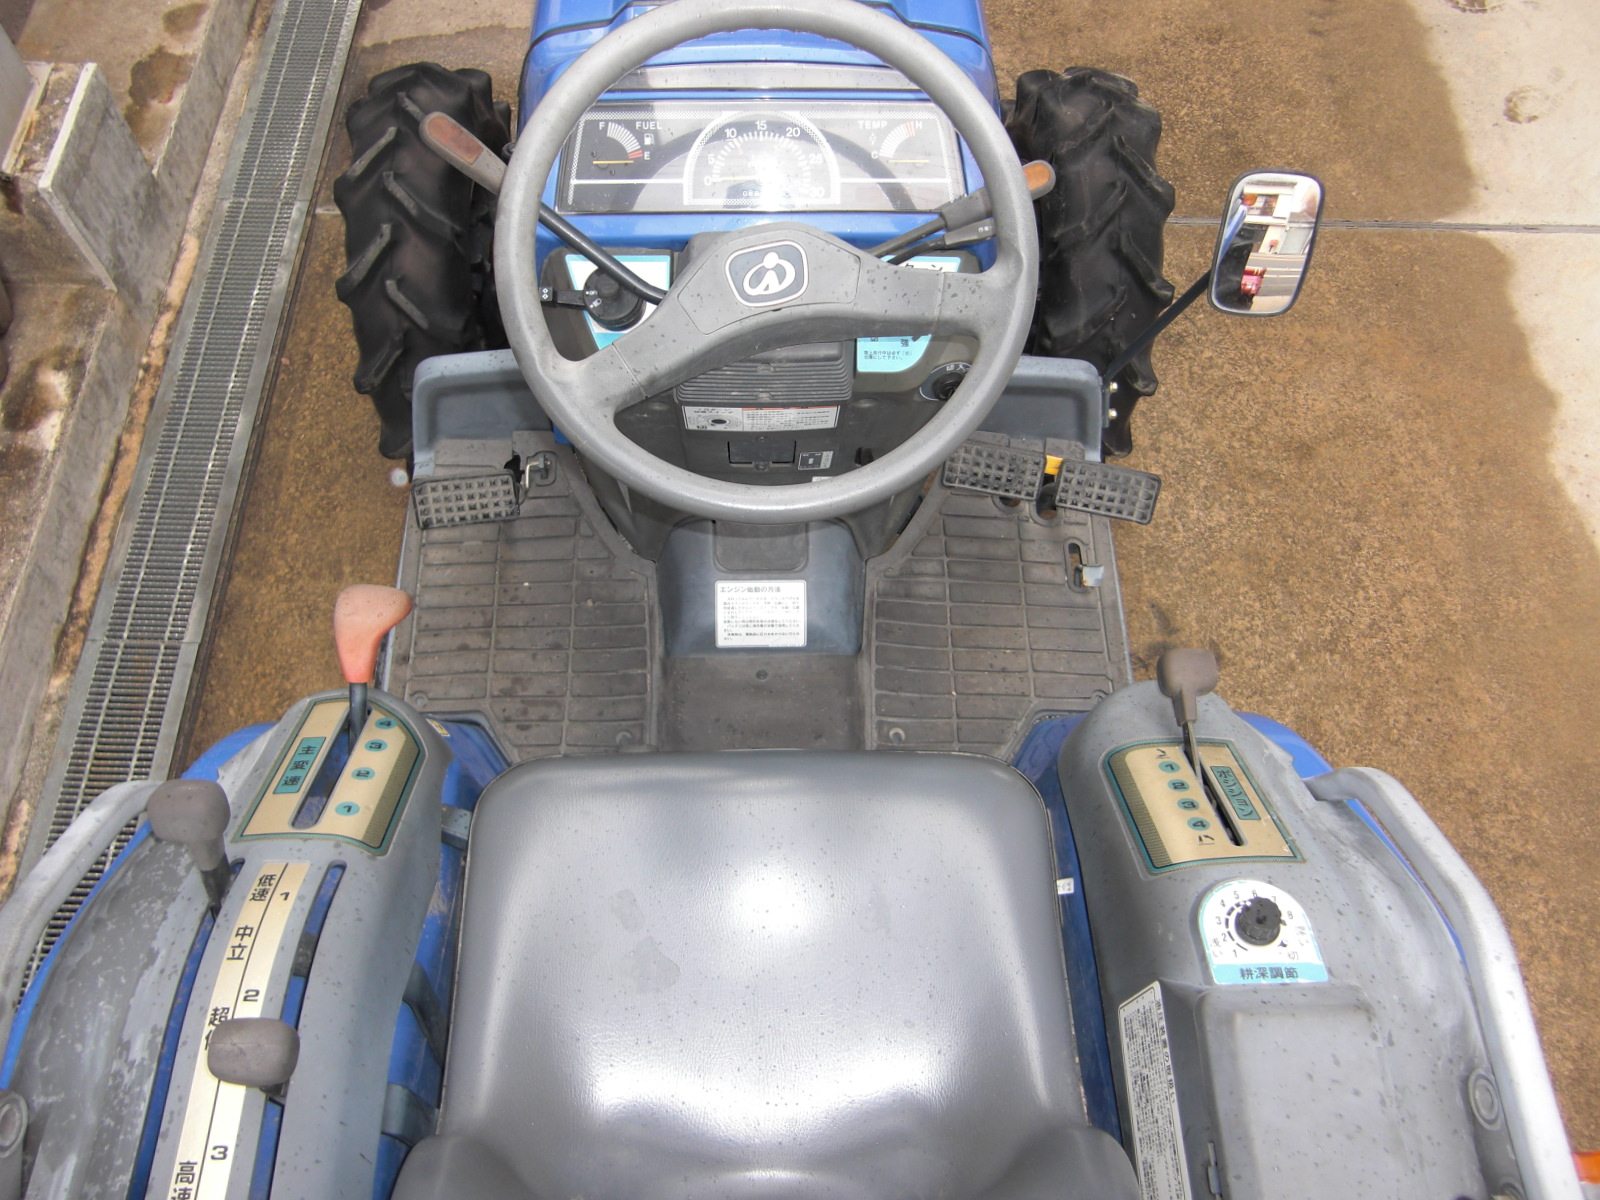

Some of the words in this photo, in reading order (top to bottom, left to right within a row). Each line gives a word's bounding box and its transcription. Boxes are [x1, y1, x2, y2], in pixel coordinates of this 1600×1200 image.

[599, 121, 606, 131] F
[635, 120, 663, 130] FUEL
[754, 120, 768, 131] 15
[857, 120, 888, 130] TEMP
[915, 120, 923, 129] H
[724, 128, 738, 139] 10
[785, 127, 801, 138] 20
[643, 150, 651, 161] E
[707, 154, 717, 165] 5
[808, 153, 823, 165] 25
[870, 151, 880, 160] C
[703, 176, 712, 186] 0
[808, 186, 825, 198] 30
[378, 719, 393, 728] 4
[368, 741, 383, 750] 3
[282, 746, 317, 787] 主変速
[1165, 763, 1176, 771] 1
[355, 769, 371, 778] 2
[1218, 769, 1253, 816] ポジション
[341, 804, 353, 814] 1
[1182, 801, 1196, 809] 3
[1191, 819, 1207, 828] 4
[248, 872, 276, 903] 低速
[279, 891, 291, 902] 1
[1233, 890, 1240, 900] 5
[1219, 898, 1227, 908] 4
[1286, 910, 1295, 920] 8
[1215, 916, 1223, 926] 3
[1221, 933, 1228, 942] 2
[226, 924, 254, 962] 中立
[1232, 949, 1239, 958] 1
[1239, 966, 1299, 980] 耕深調節
[242, 988, 260, 1002] 2
[210, 1144, 229, 1161] 3
